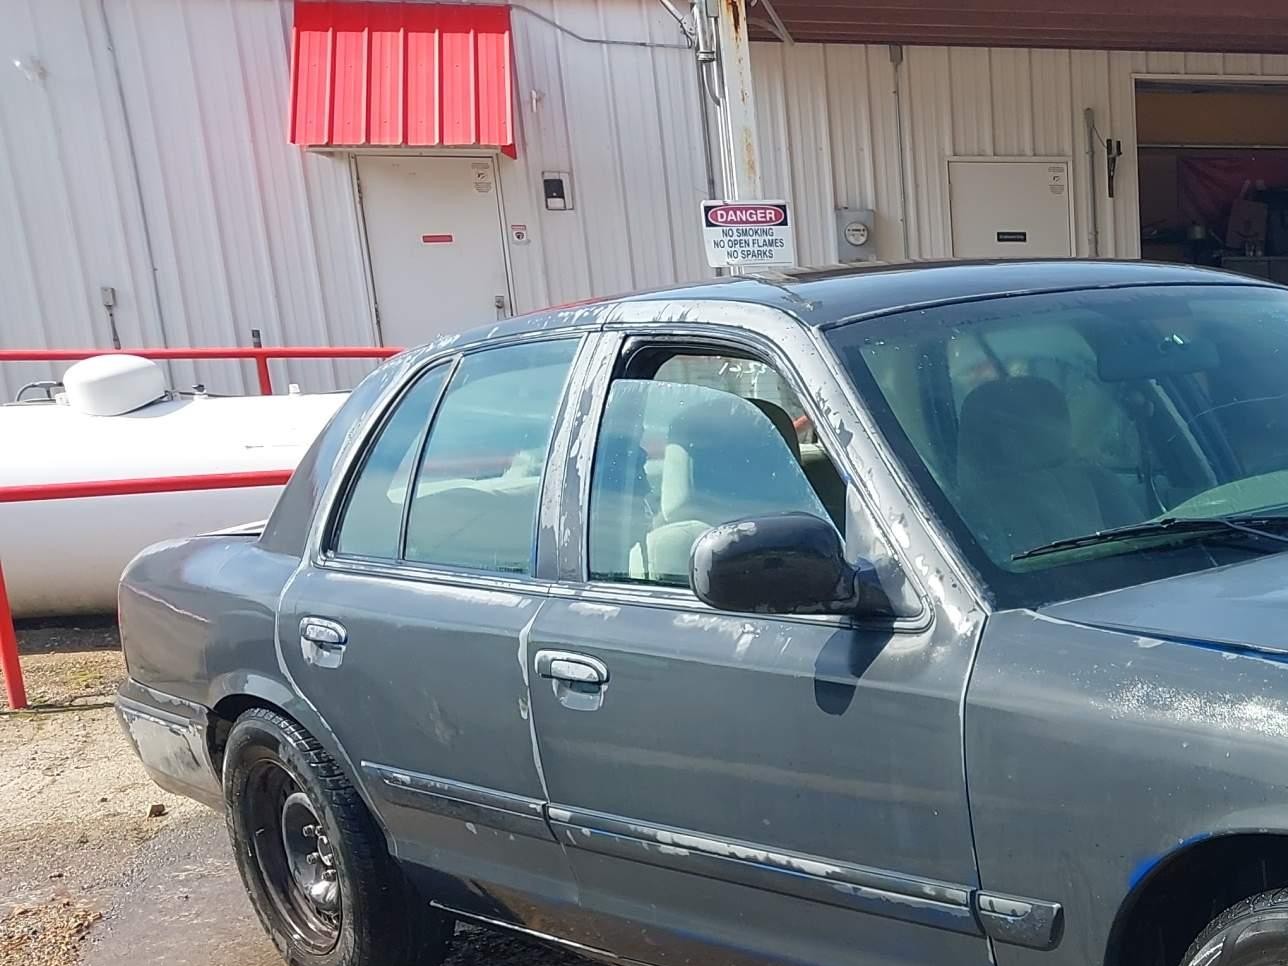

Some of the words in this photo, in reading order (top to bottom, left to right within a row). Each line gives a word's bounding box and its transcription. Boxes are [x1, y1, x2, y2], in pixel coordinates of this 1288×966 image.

[717, 209, 776, 222] DANGER
[721, 228, 734, 238] NO
[735, 227, 774, 238] SMOKING
[713, 239, 726, 249] NO
[727, 238, 750, 249] OPEN
[752, 238, 785, 248] FLAMES
[726, 250, 739, 259] NO
[740, 249, 774, 259] SPARKS
